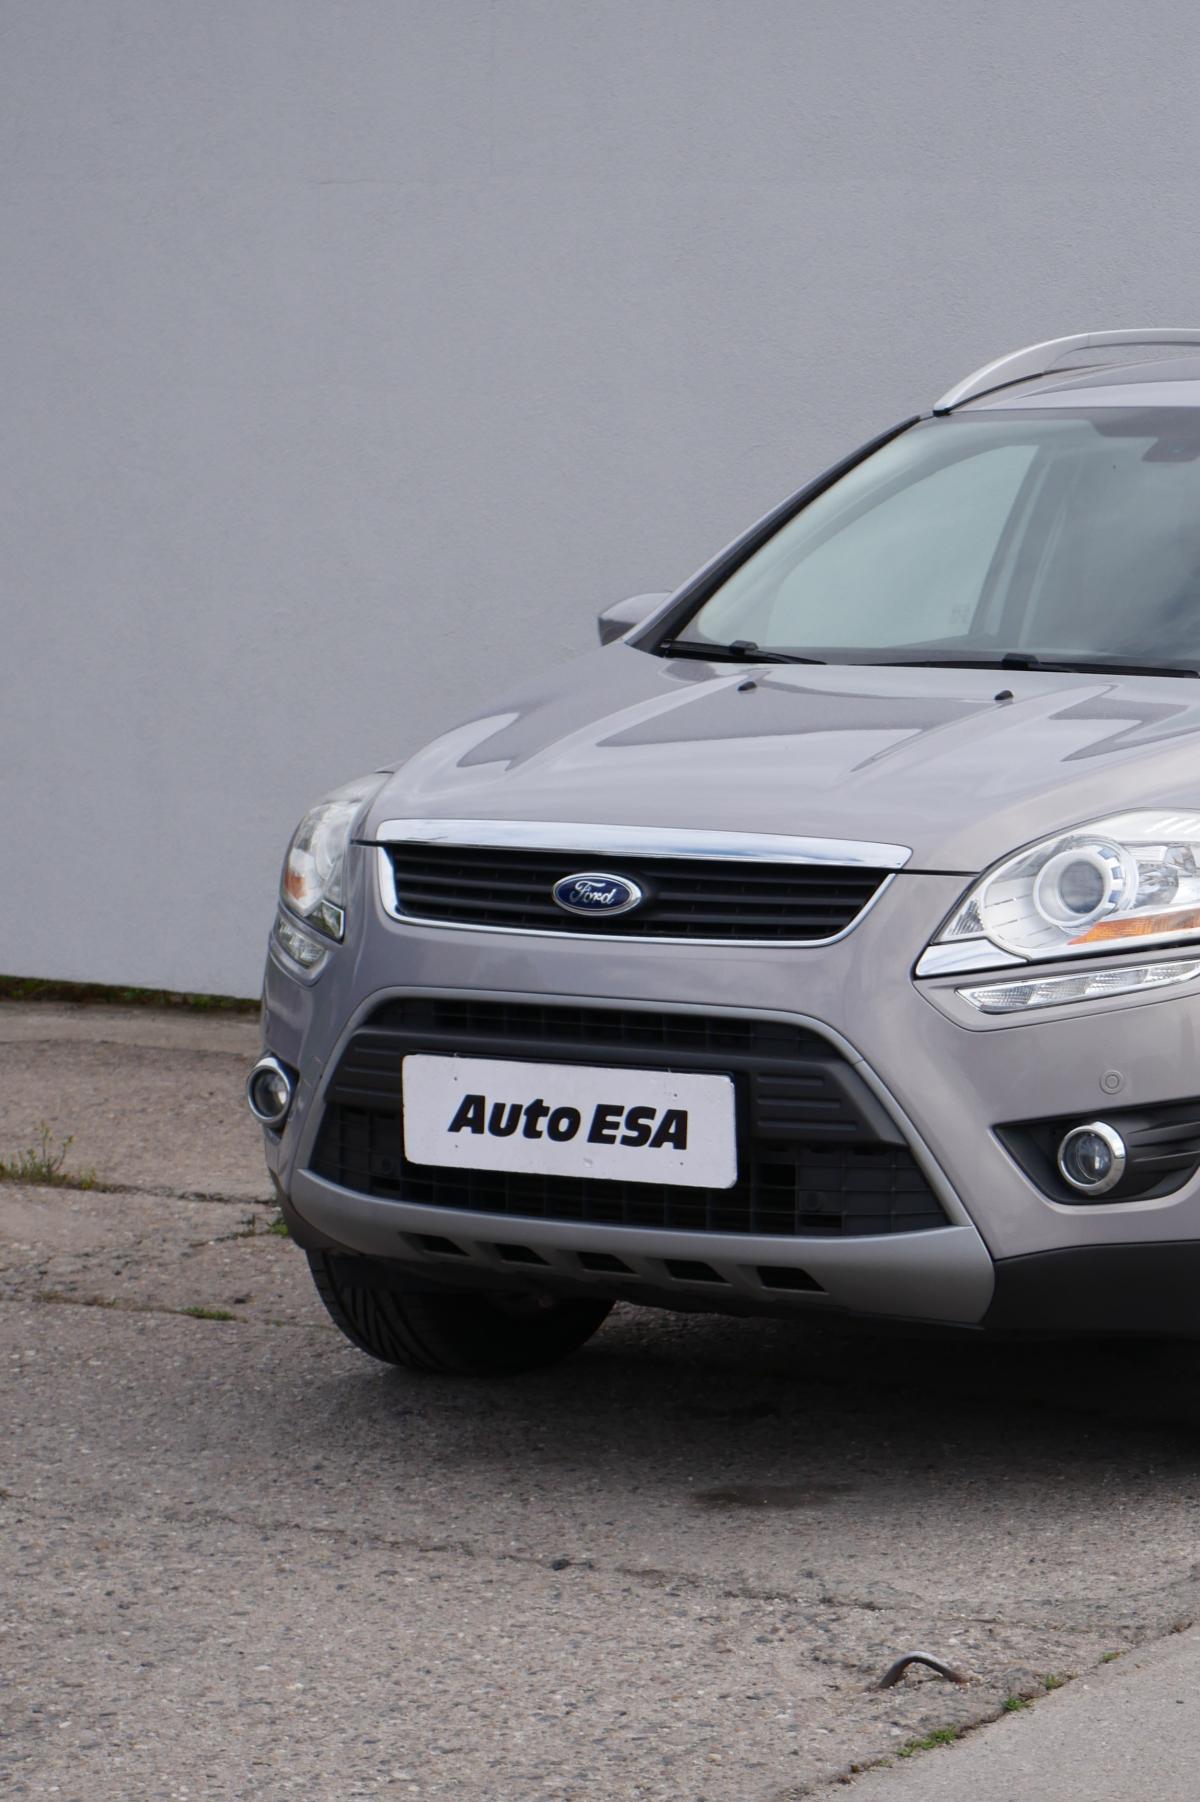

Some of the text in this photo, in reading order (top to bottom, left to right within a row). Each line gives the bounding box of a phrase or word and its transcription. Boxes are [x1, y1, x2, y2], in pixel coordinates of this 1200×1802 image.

[569, 880, 617, 905] Ford
[447, 1094, 689, 1151] Auto ESA
